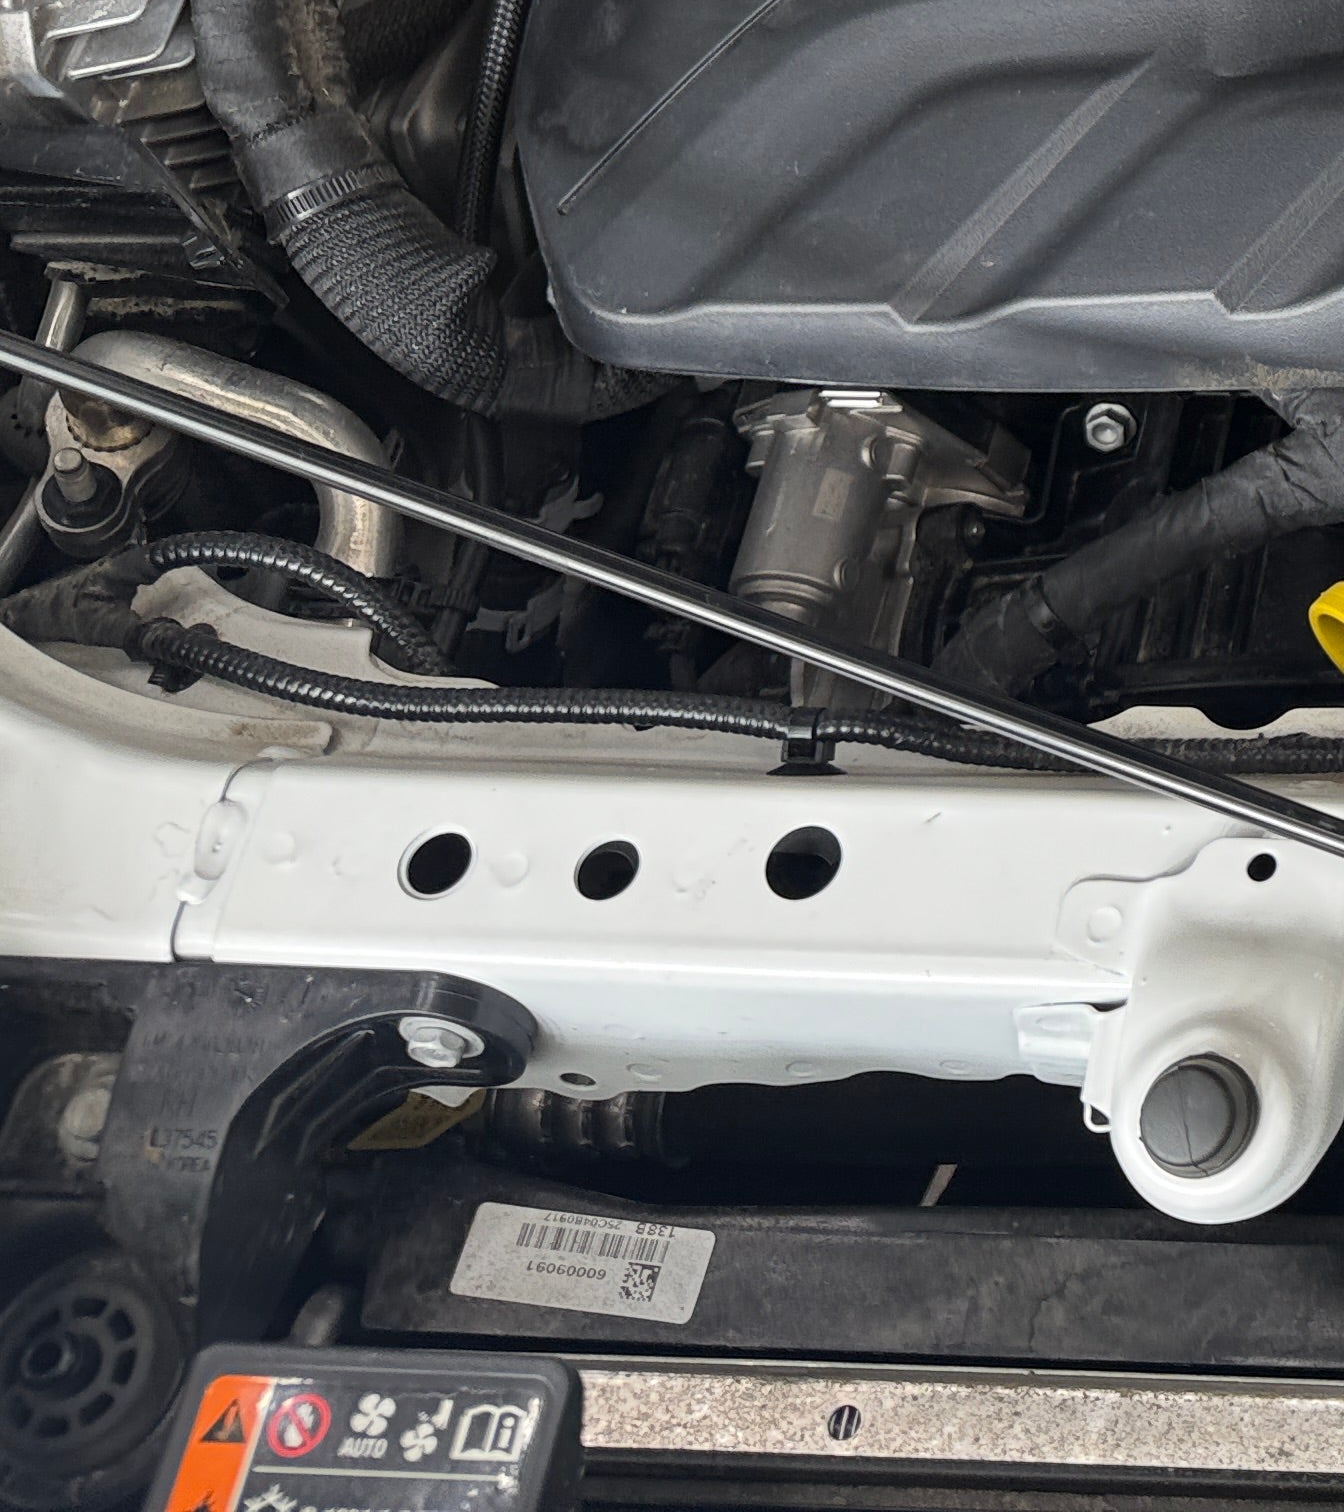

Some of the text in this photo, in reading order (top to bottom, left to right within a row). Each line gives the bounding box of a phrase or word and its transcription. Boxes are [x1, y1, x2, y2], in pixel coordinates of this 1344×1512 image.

[634, 1222, 676, 1239] 138B
[525, 1260, 608, 1281] 60009091
[338, 1437, 389, 1459] AUTO
